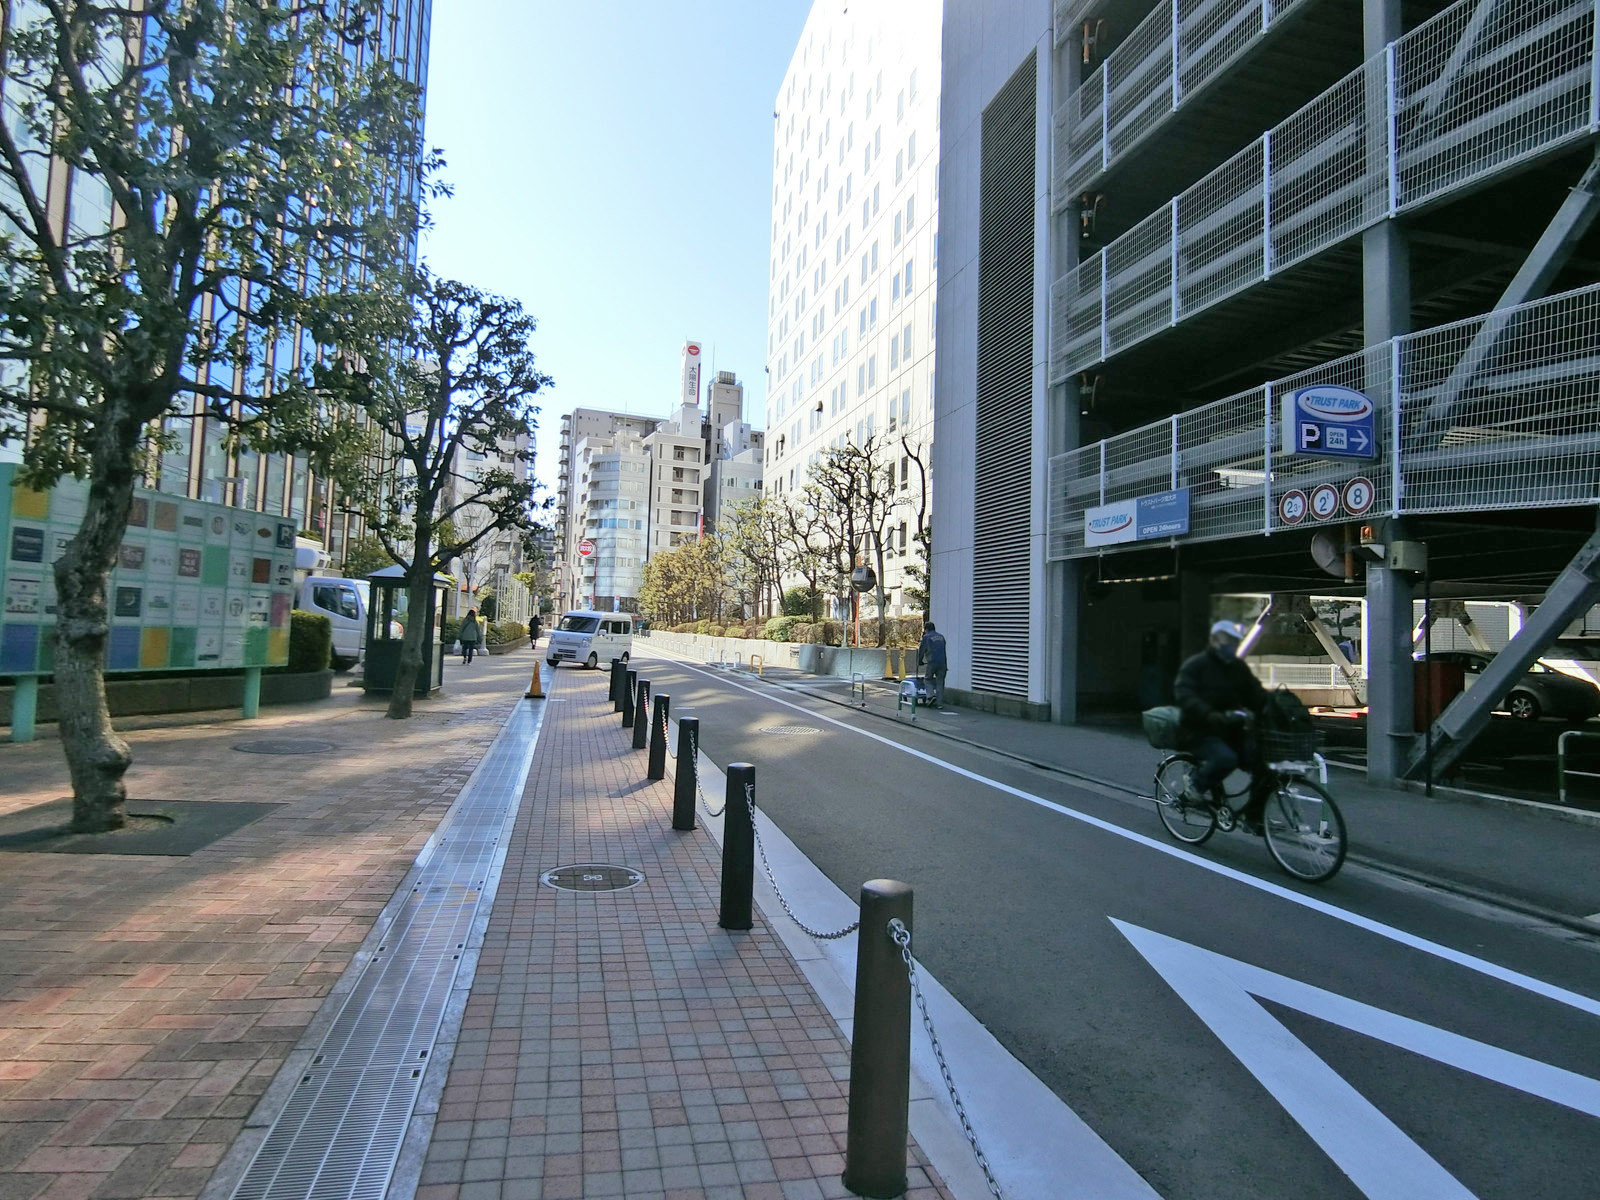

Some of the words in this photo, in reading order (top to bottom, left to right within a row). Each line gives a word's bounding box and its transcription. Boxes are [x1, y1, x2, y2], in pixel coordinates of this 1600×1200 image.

[1310, 395, 1338, 407] TRUST
[1338, 398, 1361, 410] PARK
[1301, 423, 1320, 449] P
[1329, 437, 1345, 445] 24h
[1353, 488, 1363, 505] 8
[1091, 516, 1112, 529] TRUST
[1111, 513, 1129, 526] PARK
[1142, 525, 1158, 535] OPEN
[1158, 523, 1181, 532] 24hours
